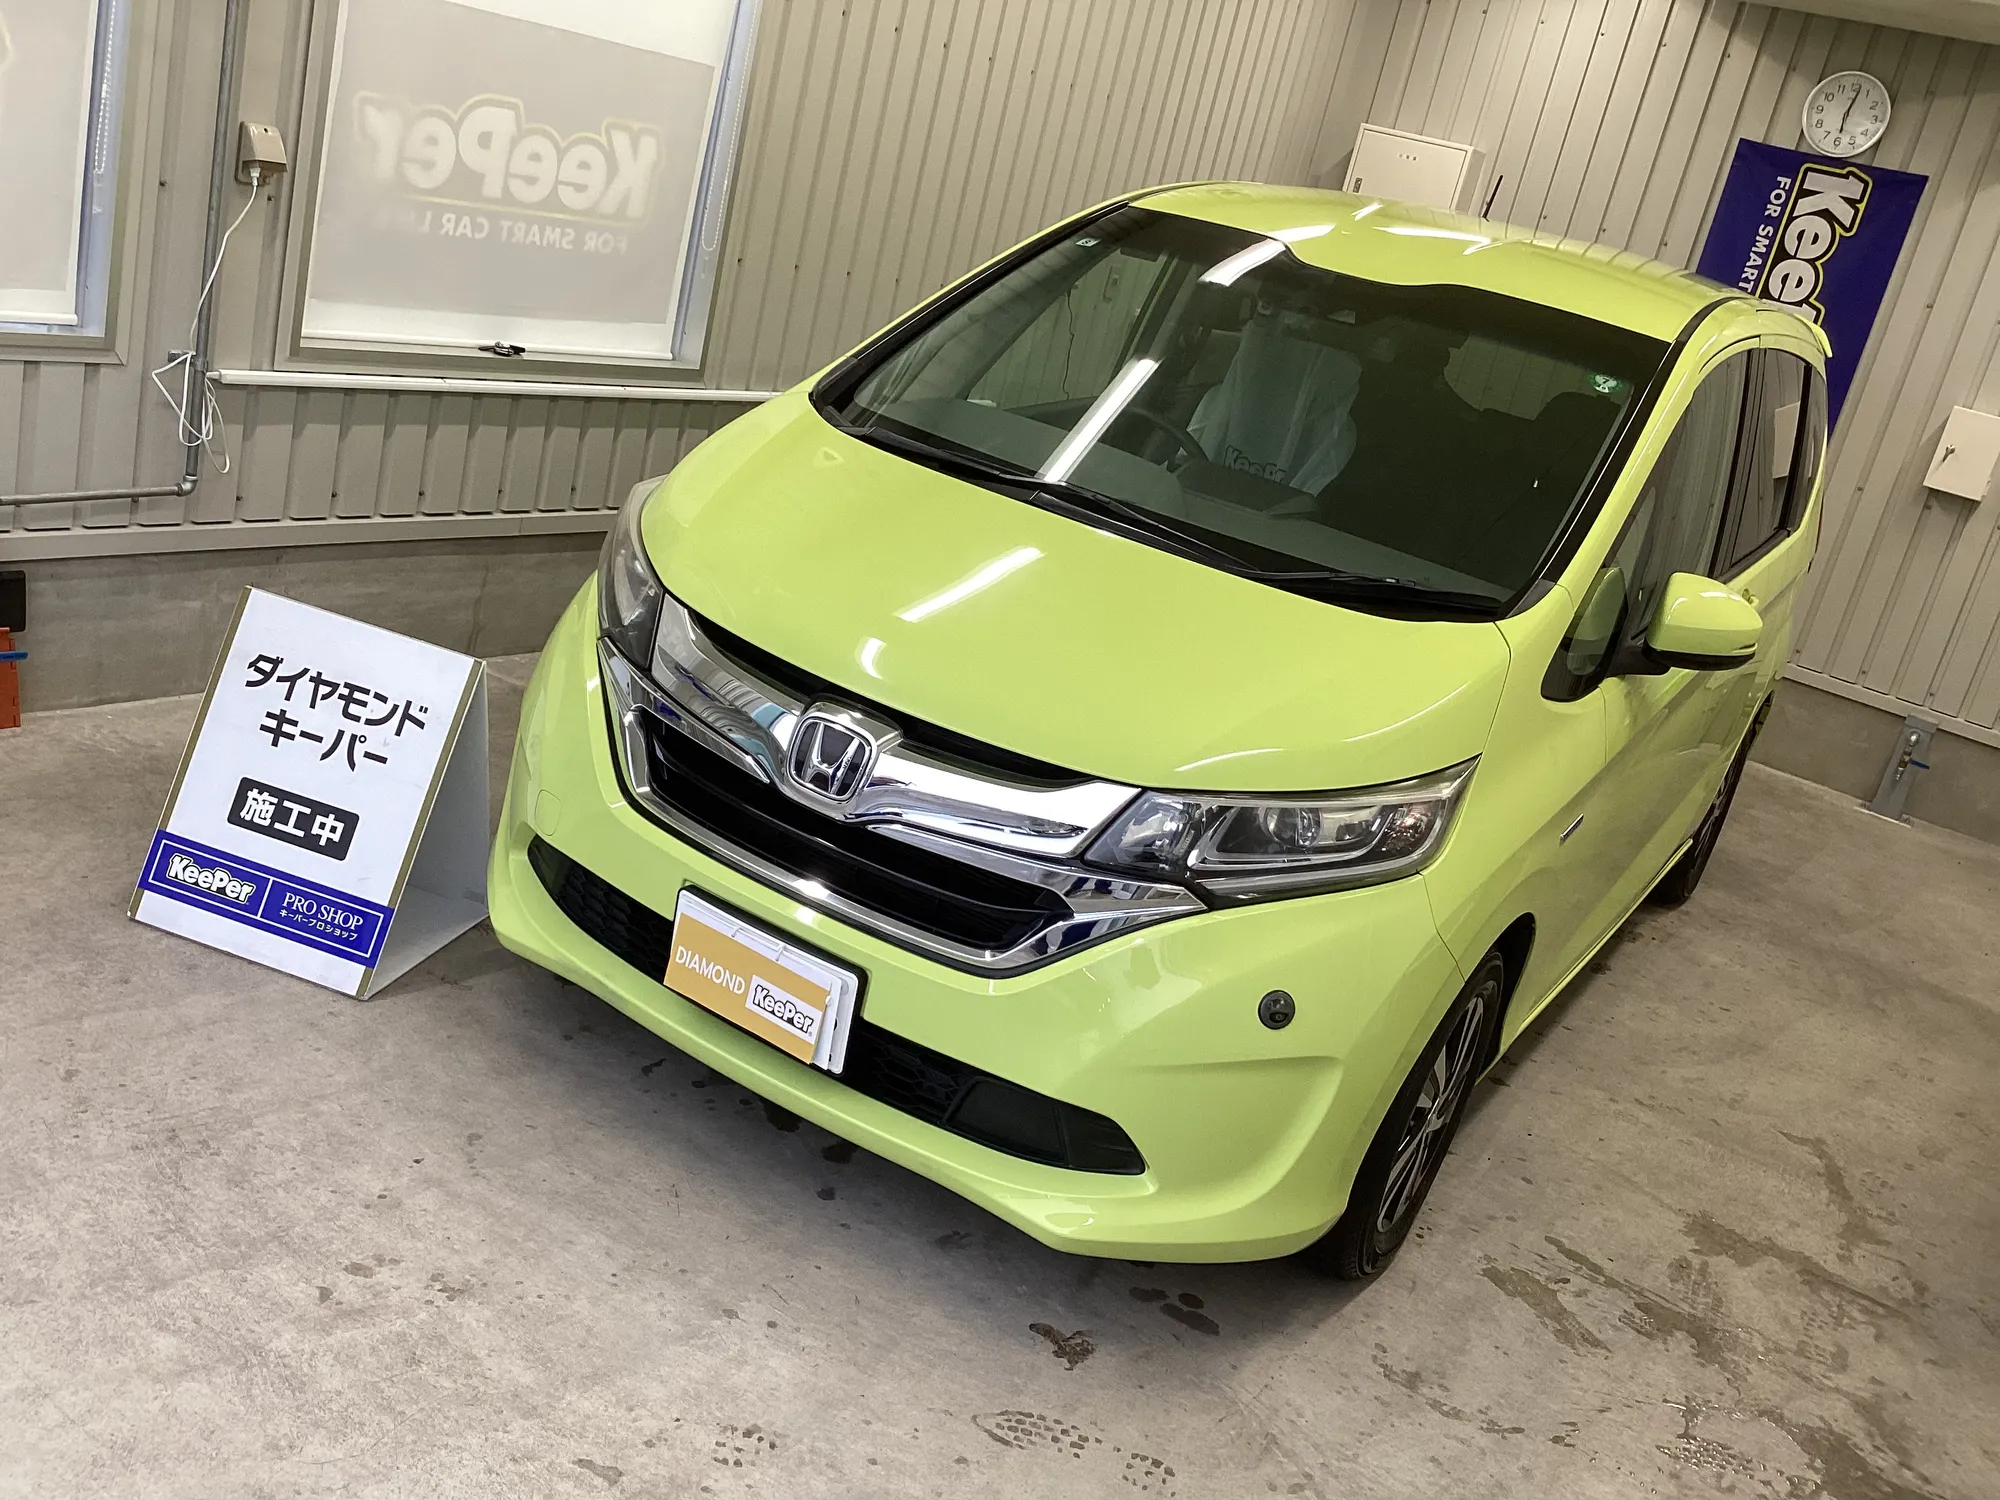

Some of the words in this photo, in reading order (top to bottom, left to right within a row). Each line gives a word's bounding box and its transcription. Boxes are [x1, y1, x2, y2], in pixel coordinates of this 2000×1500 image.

[1837, 84, 1846, 94] 11
[1865, 88, 1871, 98] 1
[1824, 92, 1835, 102] 10
[1815, 104, 1824, 114] 9
[1869, 100, 1879, 110] 2
[1815, 119, 1824, 128] 8
[1869, 115, 1879, 125] 3
[1823, 130, 1831, 140] 7
[1860, 128, 1869, 137] 4
[1833, 136, 1842, 146] 6
[1847, 135, 1857, 145] 5
[1764, 176, 1792, 217] FOR
[1738, 224, 1774, 293] SMART
[245, 654, 428, 737] ダイヤモンド
[259, 709, 389, 772] キーパー
[239, 787, 346, 848] 施工中
[167, 853, 255, 904] KeePer
[282, 892, 317, 915] PRO
[318, 904, 363, 931] SHOP
[675, 945, 746, 995] DIAMOND
[752, 983, 815, 1034] KeePer
